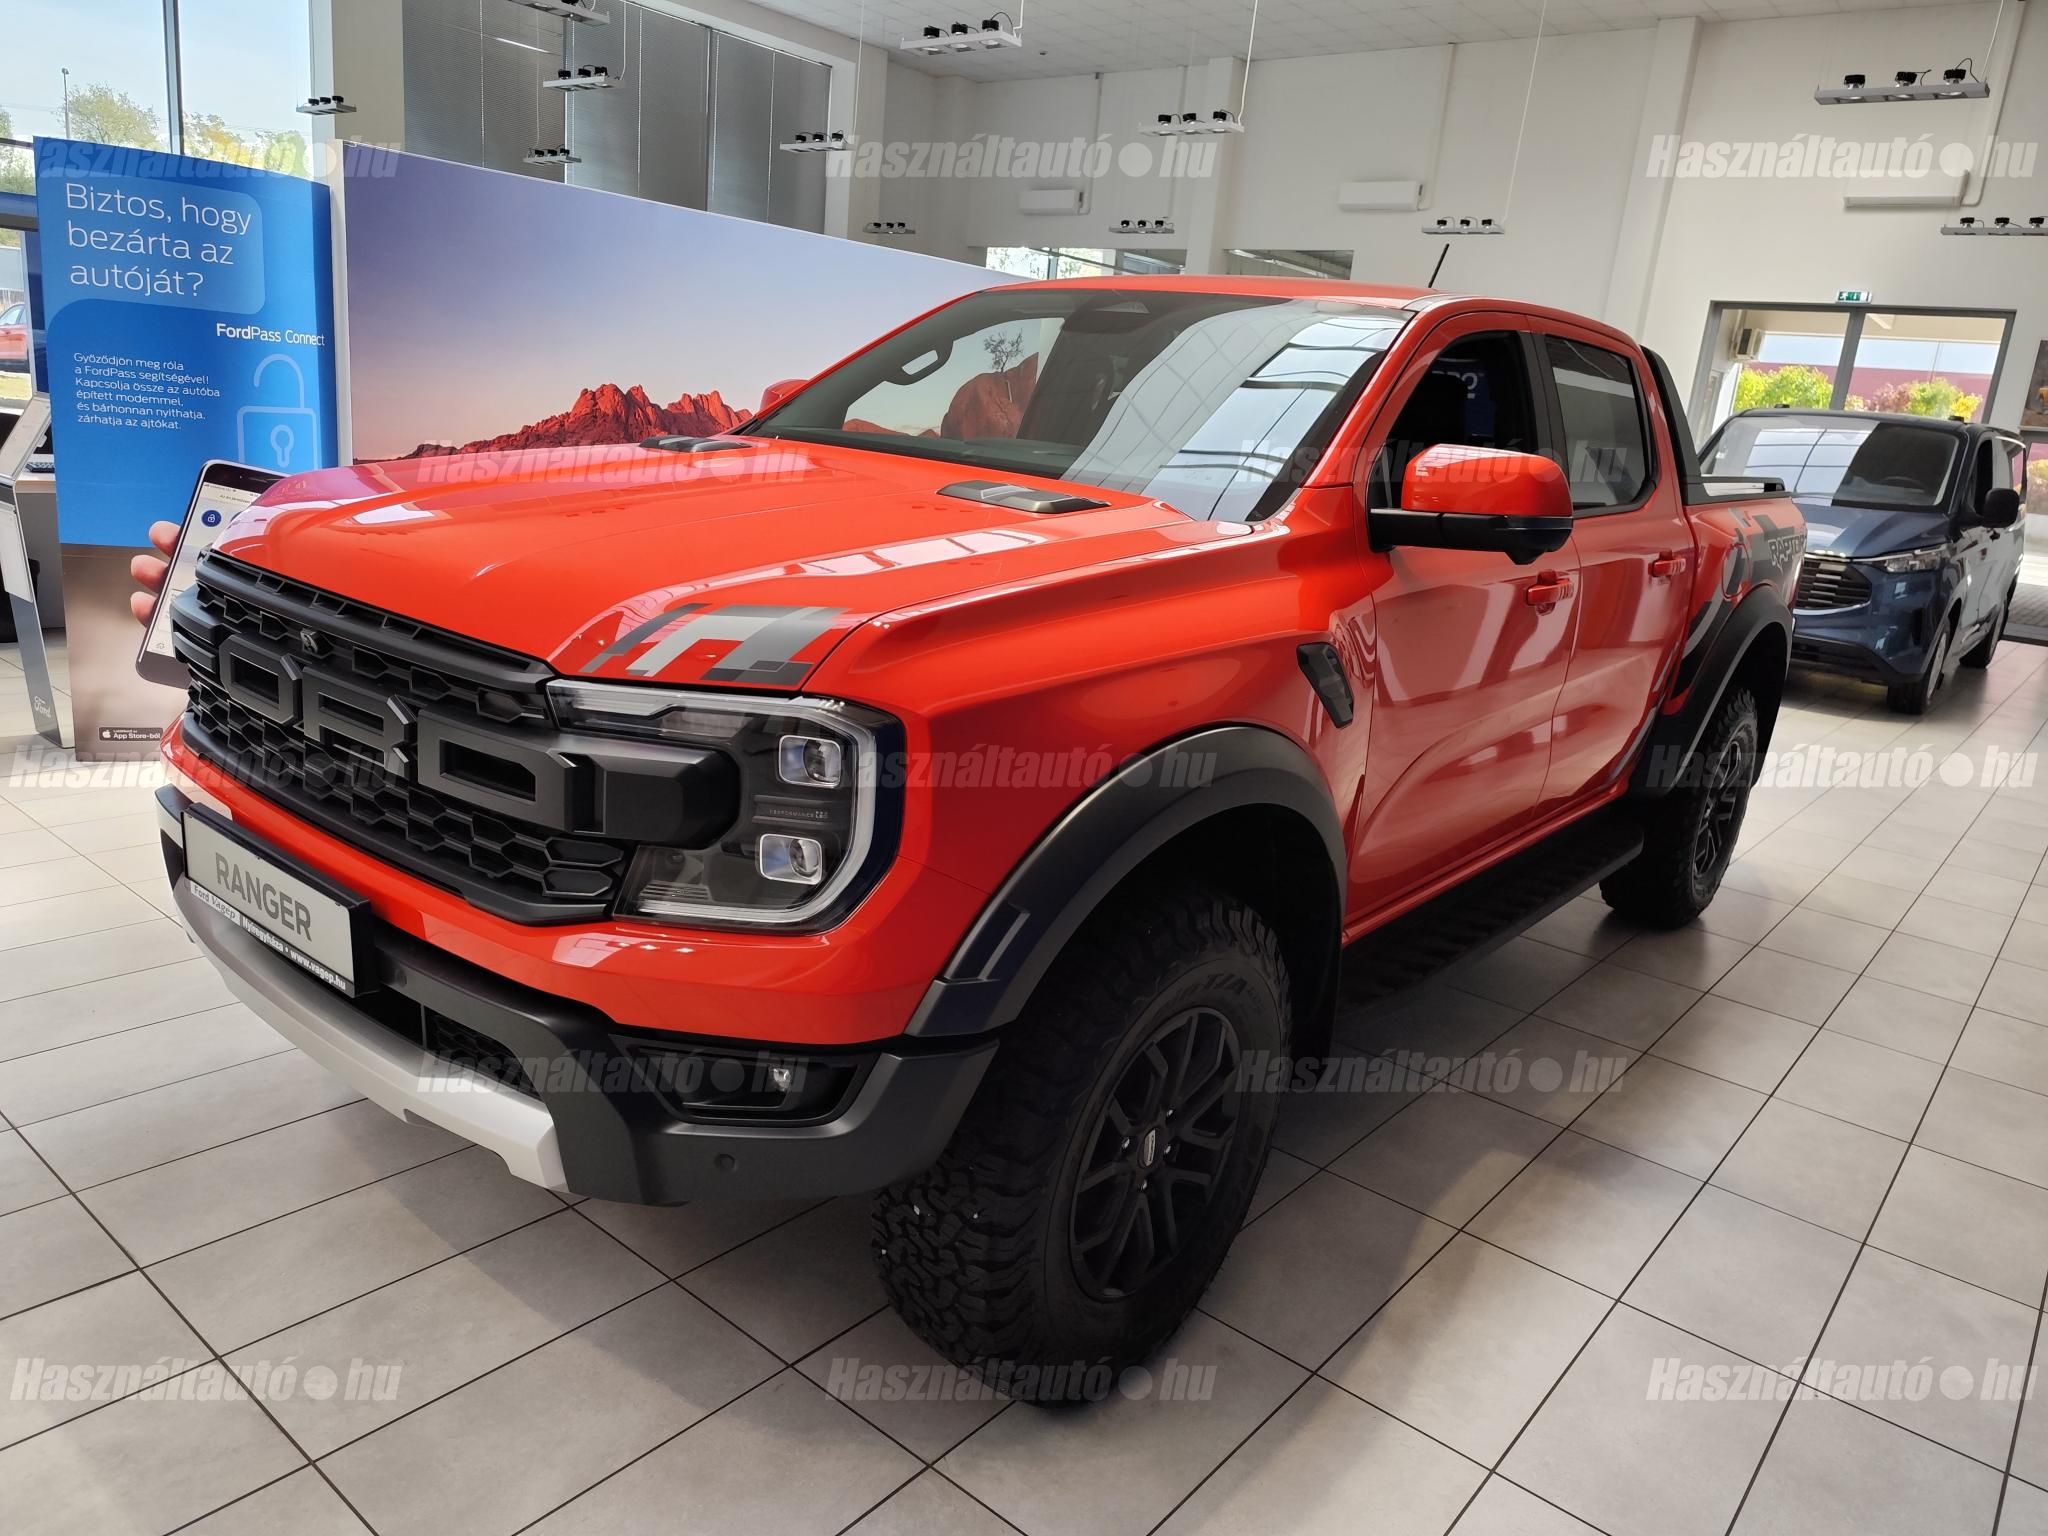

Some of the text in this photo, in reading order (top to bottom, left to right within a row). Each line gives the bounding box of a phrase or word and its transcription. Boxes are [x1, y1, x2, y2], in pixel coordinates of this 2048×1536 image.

[66, 182, 251, 236] Biztos, hogy
[67, 220, 234, 265] bezárta az
[70, 264, 204, 297] autóját?
[216, 323, 325, 346] FordPass Connect
[74, 366, 82, 374] a
[85, 366, 137, 379] FordPass
[135, 358, 161, 370] meg
[163, 360, 184, 371] róla
[75, 377, 130, 391] Kapcsolja
[167, 386, 179, 394] az
[182, 386, 220, 397] autóba
[77, 402, 90, 411] és
[92, 402, 153, 416] bárhonnan
[78, 414, 122, 426] zárhatja
[125, 419, 138, 427] az
[194, 884, 210, 902] Ford
[215, 852, 312, 942] RANGER
